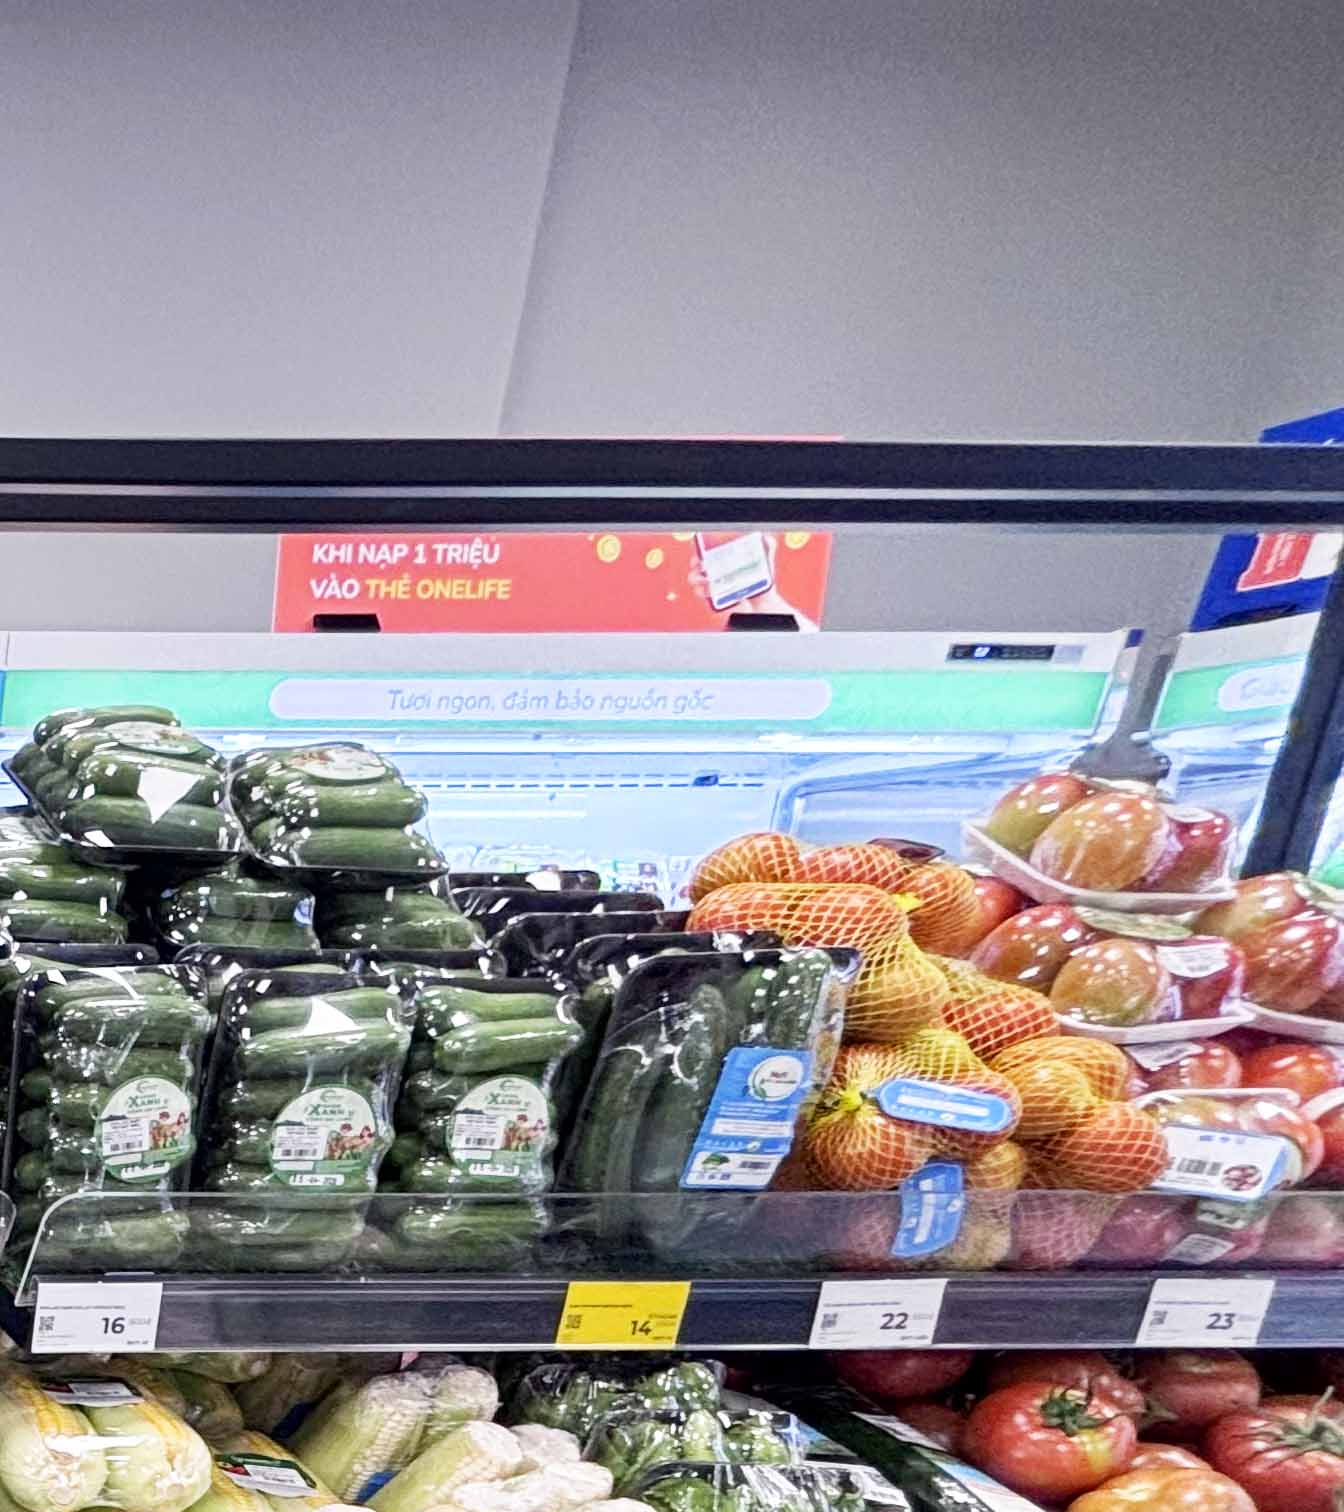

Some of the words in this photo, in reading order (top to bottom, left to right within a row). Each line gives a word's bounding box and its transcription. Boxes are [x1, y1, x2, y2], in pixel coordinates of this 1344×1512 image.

[312, 543, 352, 565] KHI
[358, 543, 409, 569] NẠP
[413, 543, 427, 565] 1
[431, 536, 501, 570] TRIỆU
[310, 573, 361, 599] VÀO
[366, 573, 412, 600] THẺ
[415, 578, 512, 600] ONELIFE
[102, 1316, 125, 1334] 16
[879, 1312, 909, 1330] 22
[1205, 1312, 1236, 1331] 23
